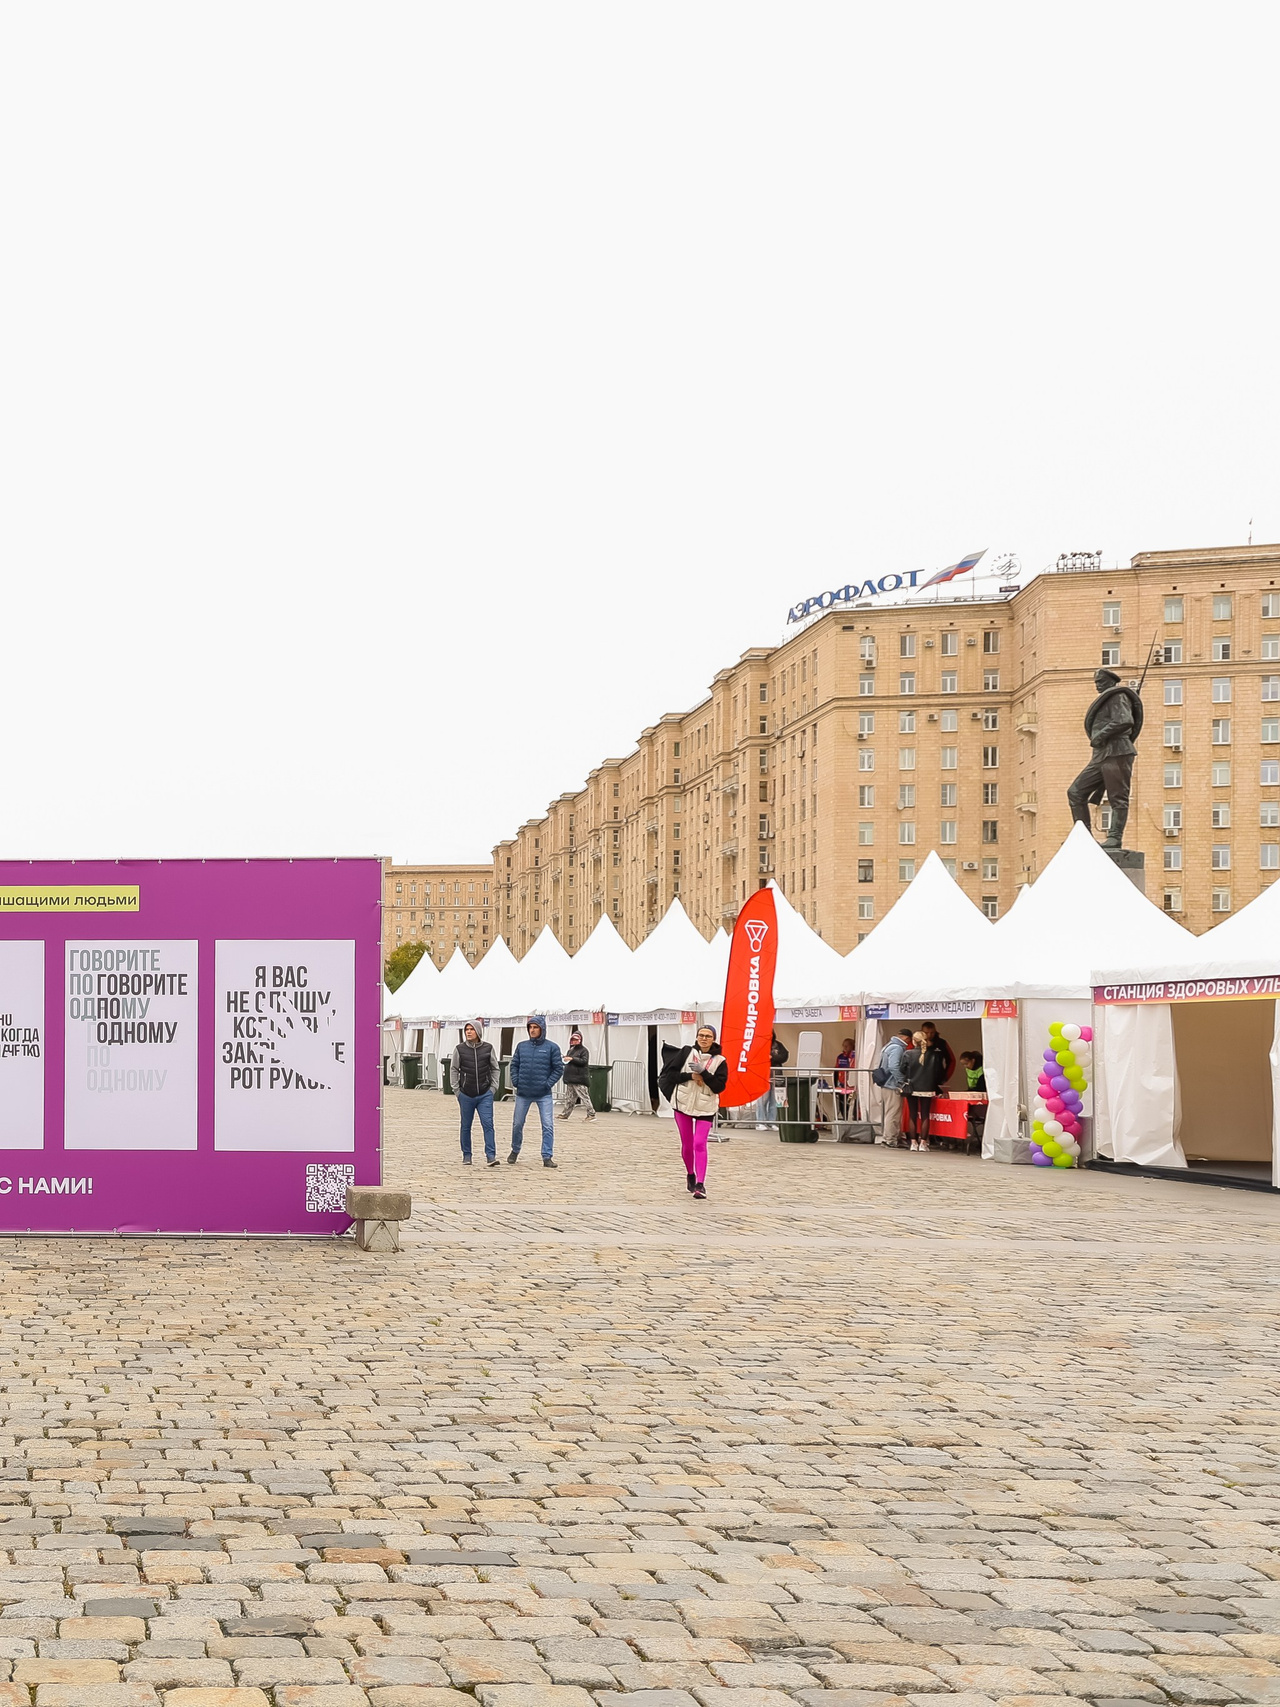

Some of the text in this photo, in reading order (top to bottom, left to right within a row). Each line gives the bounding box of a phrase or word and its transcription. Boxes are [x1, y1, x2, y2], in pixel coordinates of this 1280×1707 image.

[786, 569, 925, 625] АЭРОФЛОТ
[74, 896, 137, 907] людьми
[69, 949, 161, 971] ГОВОРИТЕ
[69, 973, 188, 996] ПО ГОВОРИТЕ
[255, 965, 308, 988] Я ВАС
[1103, 984, 1164, 1000] СТАНЦИЯ
[1167, 979, 1251, 999] ЗДОРОВЫХ
[226, 991, 249, 1013] НЕ
[736, 955, 761, 1073] ГРАВИРОВКА
[1, 1028, 40, 1043] КОГДА
[96, 1021, 178, 1045] ОДНОМУ
[86, 1045, 111, 1067] ПО
[86, 1069, 168, 1093] ОДНОМУ
[230, 1066, 265, 1089] РОТ
[18, 1177, 93, 1194] НАМИ!
